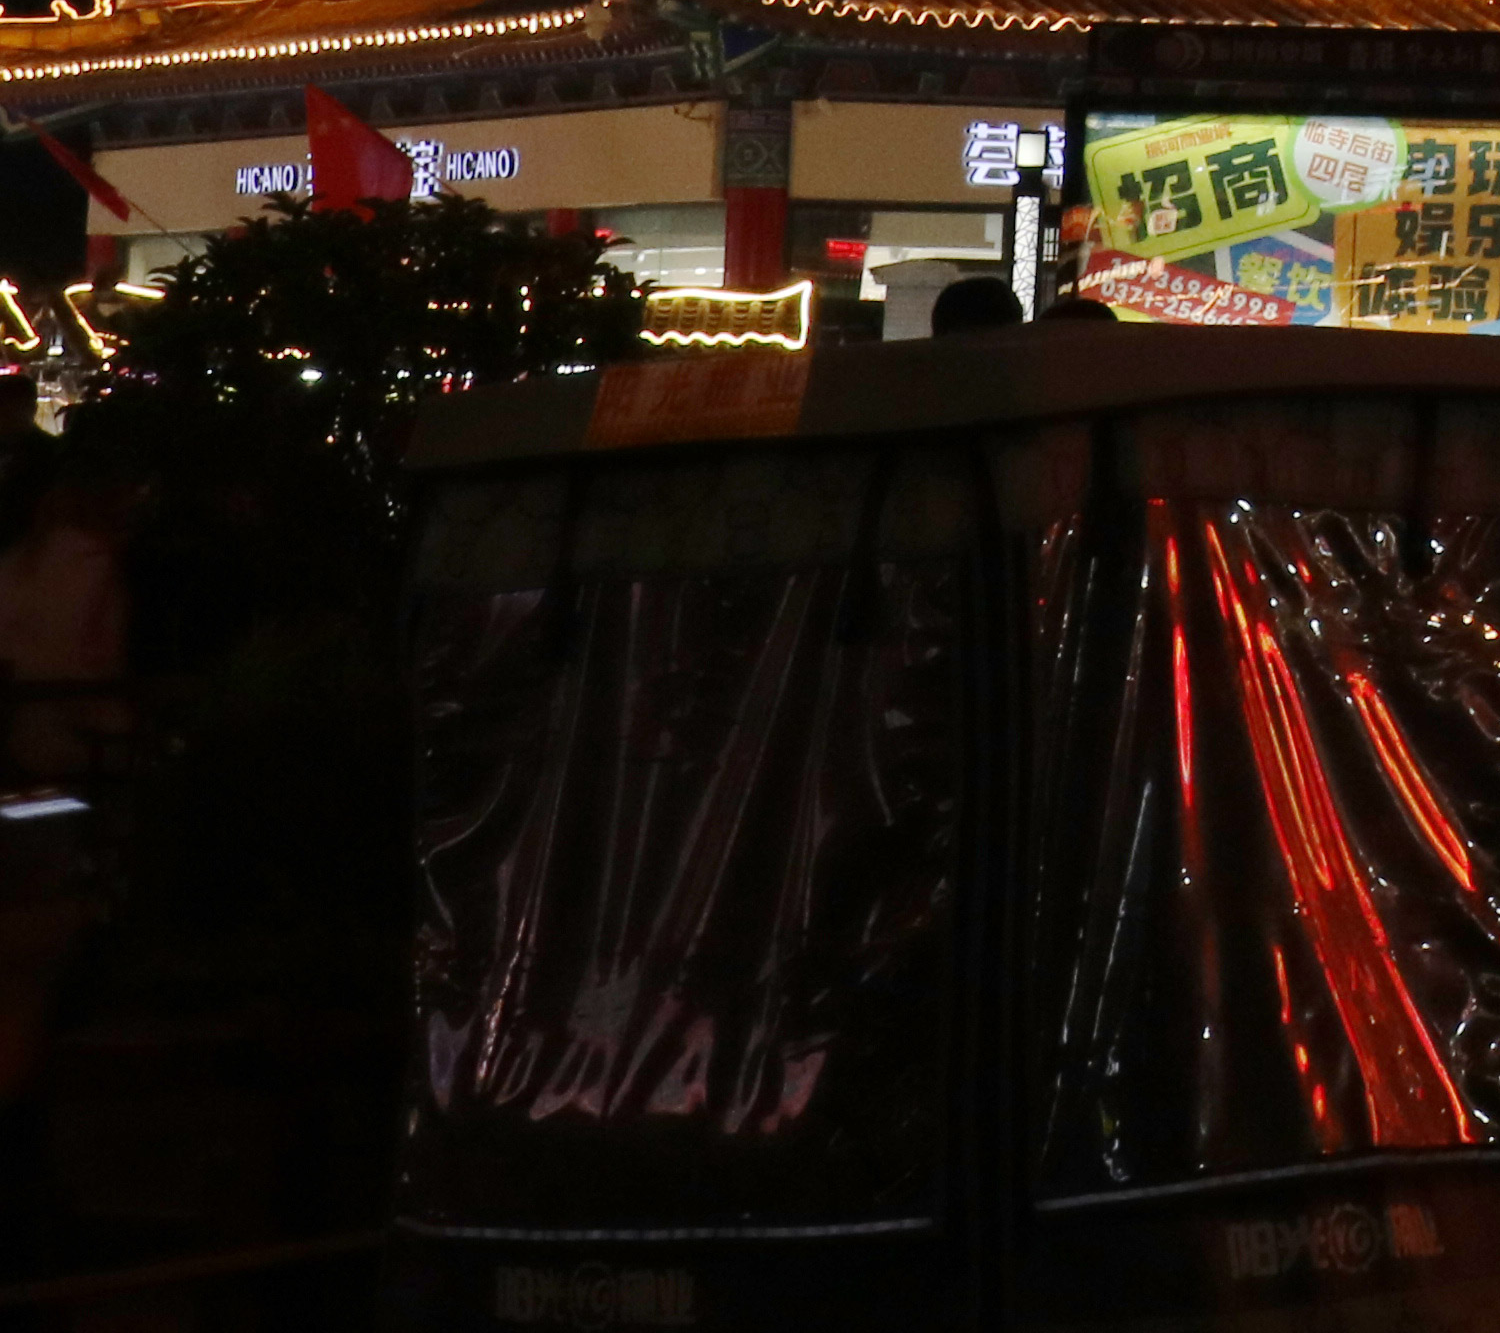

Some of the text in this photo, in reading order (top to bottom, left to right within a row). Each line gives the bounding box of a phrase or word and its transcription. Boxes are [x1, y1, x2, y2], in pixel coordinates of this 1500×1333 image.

[1306, 119, 1395, 165] 临寺后街
[1117, 137, 1289, 245] 招商
[1306, 151, 1369, 194] 四层
